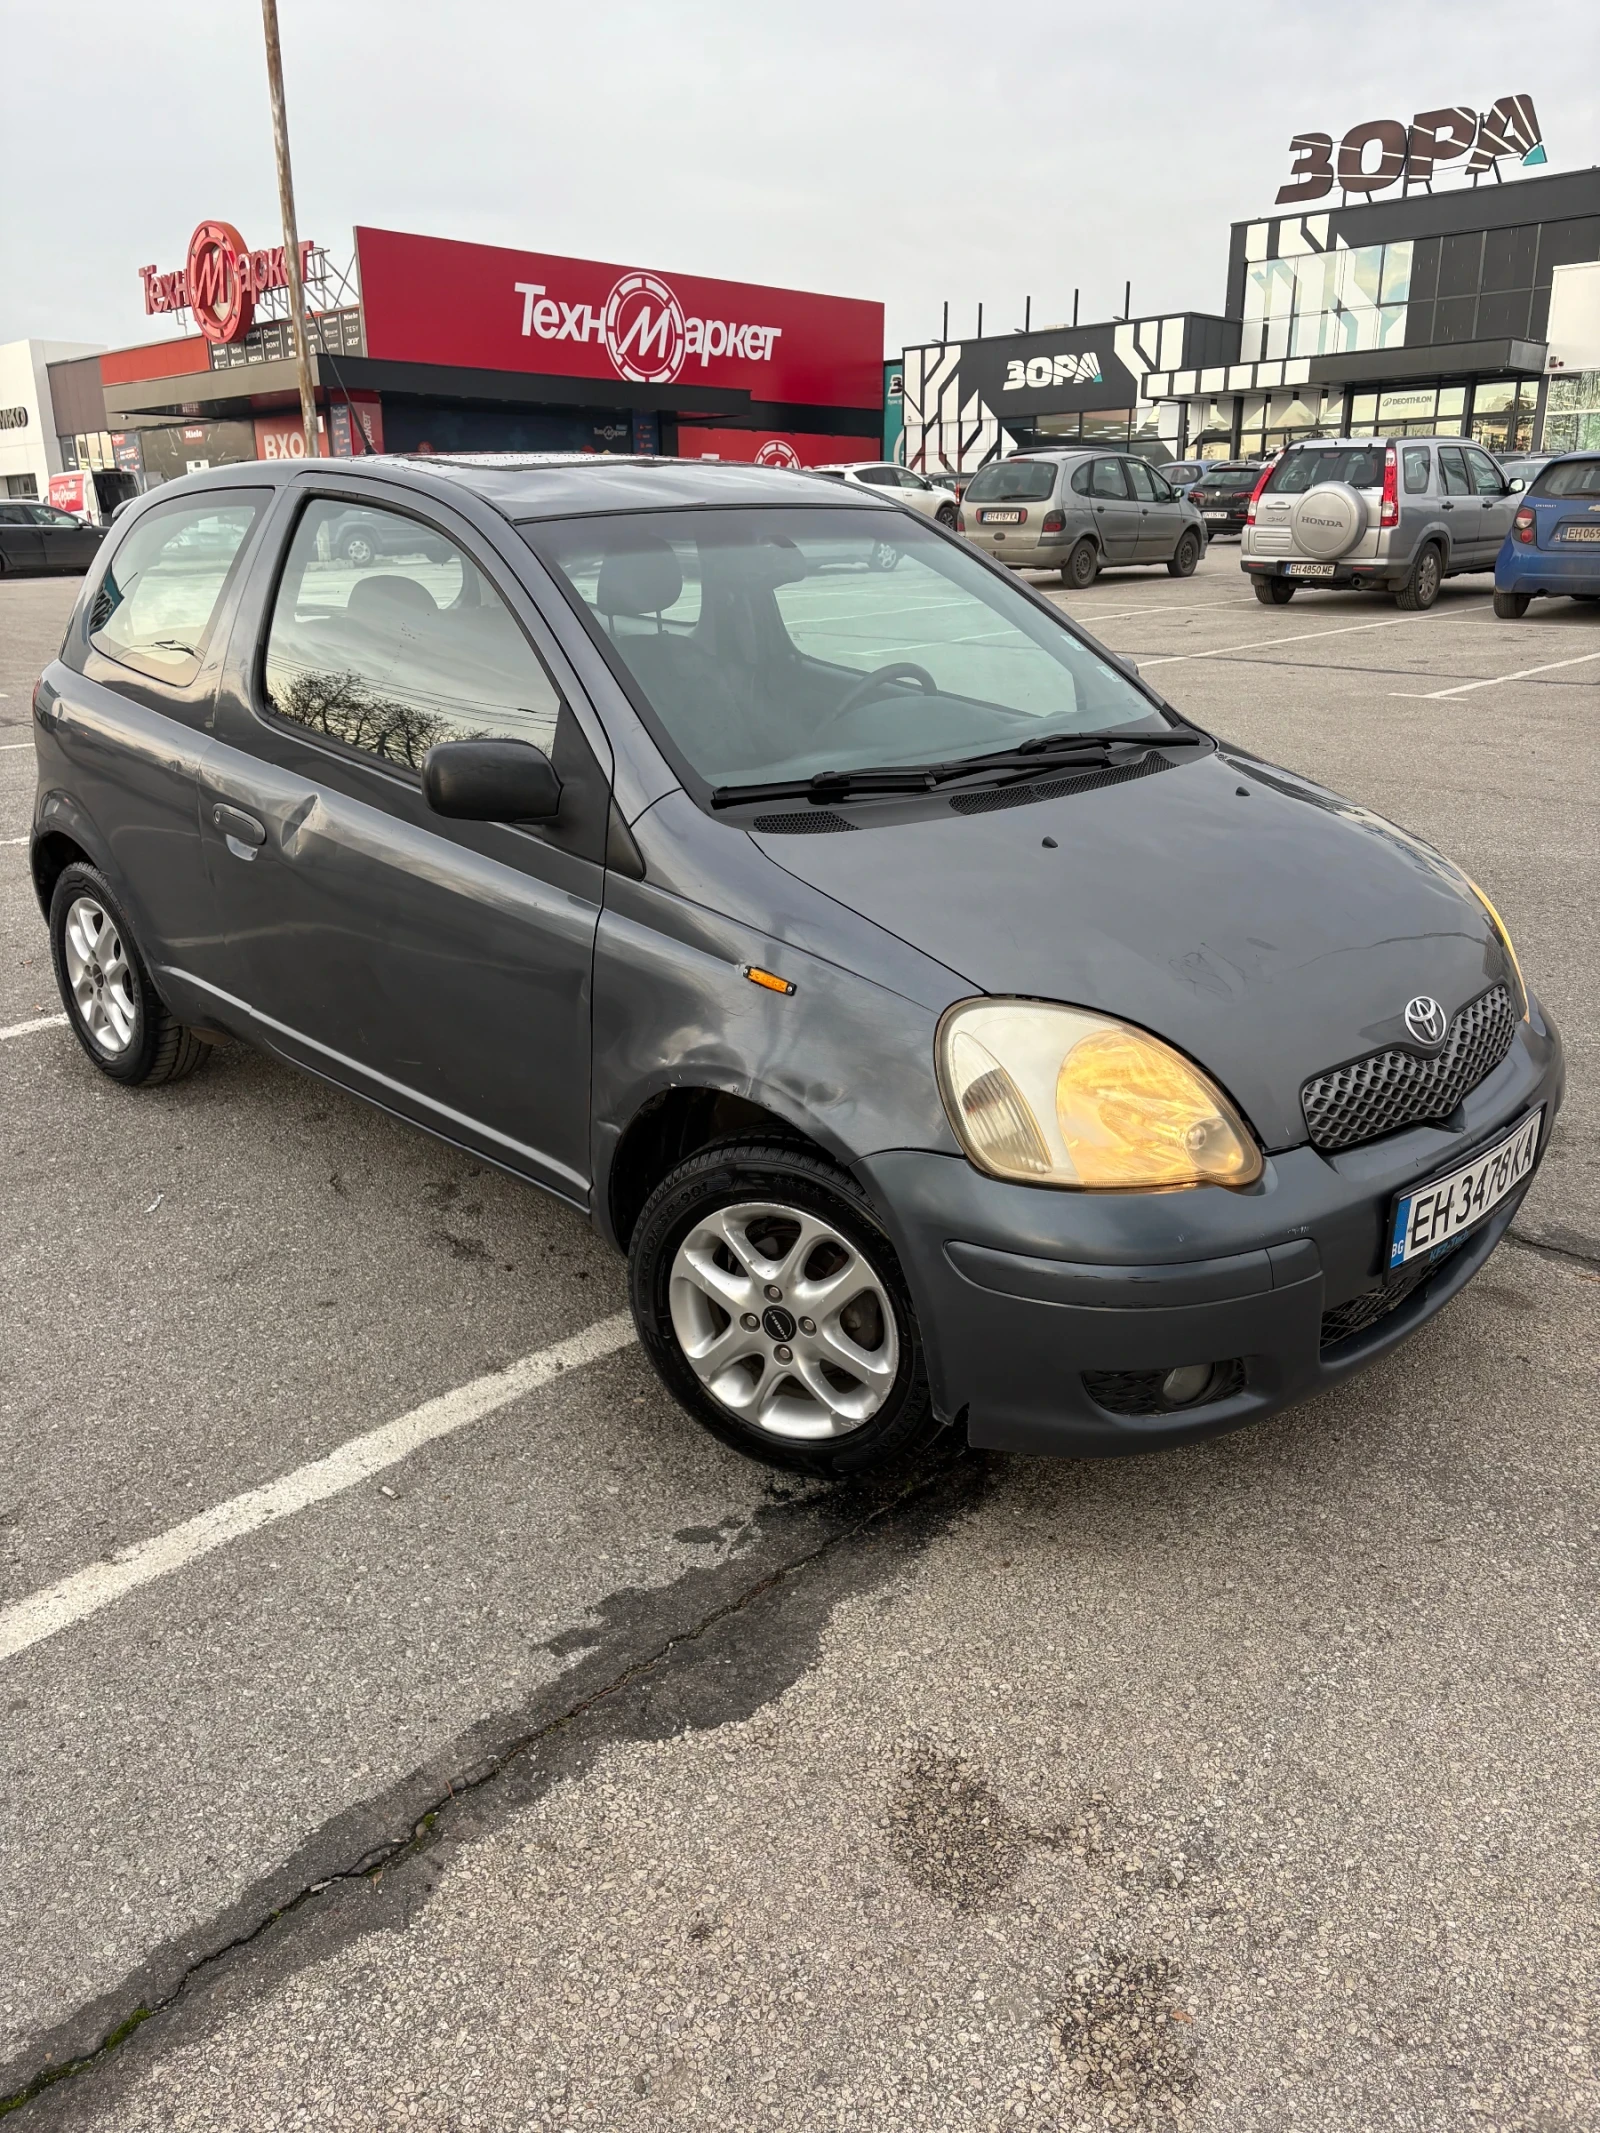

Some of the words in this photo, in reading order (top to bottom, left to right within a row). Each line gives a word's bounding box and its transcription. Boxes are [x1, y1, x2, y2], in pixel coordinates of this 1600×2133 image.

[1275, 94, 1546, 204] ЗОРА
[346, 337, 359, 346] acer
[1003, 352, 1102, 390] ЗОРА
[1392, 396, 1432, 405] DECATHLON
[1301, 516, 1343, 528] HONDA
[1568, 528, 1582, 538] EH
[1391, 1239, 1405, 1257] BG
